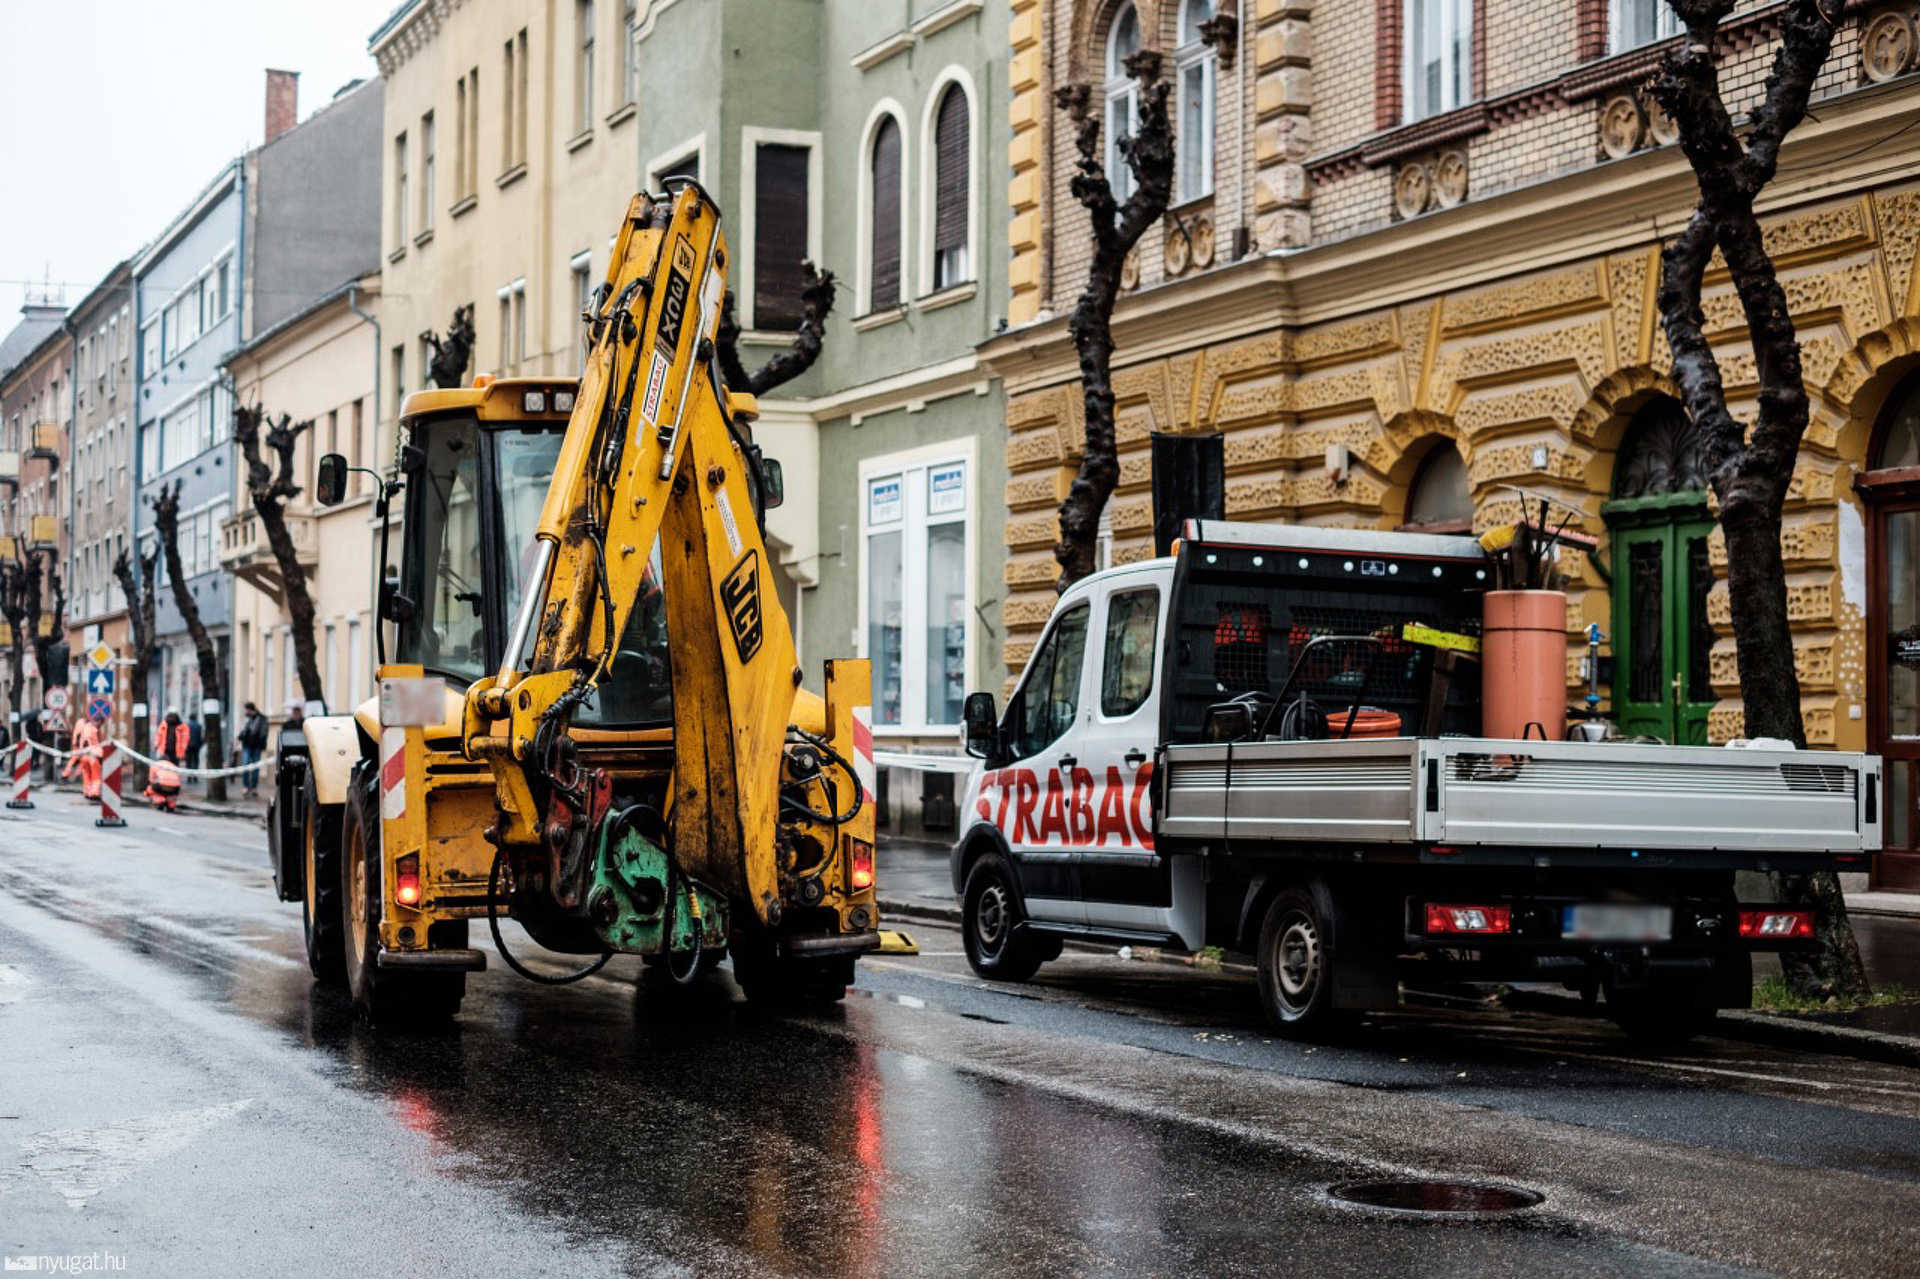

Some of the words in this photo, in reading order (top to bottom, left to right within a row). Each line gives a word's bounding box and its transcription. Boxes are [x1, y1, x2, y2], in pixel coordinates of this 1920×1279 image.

[662, 276, 685, 342] 3CX
[645, 357, 664, 420] STRABAG
[726, 567, 760, 660] JCB
